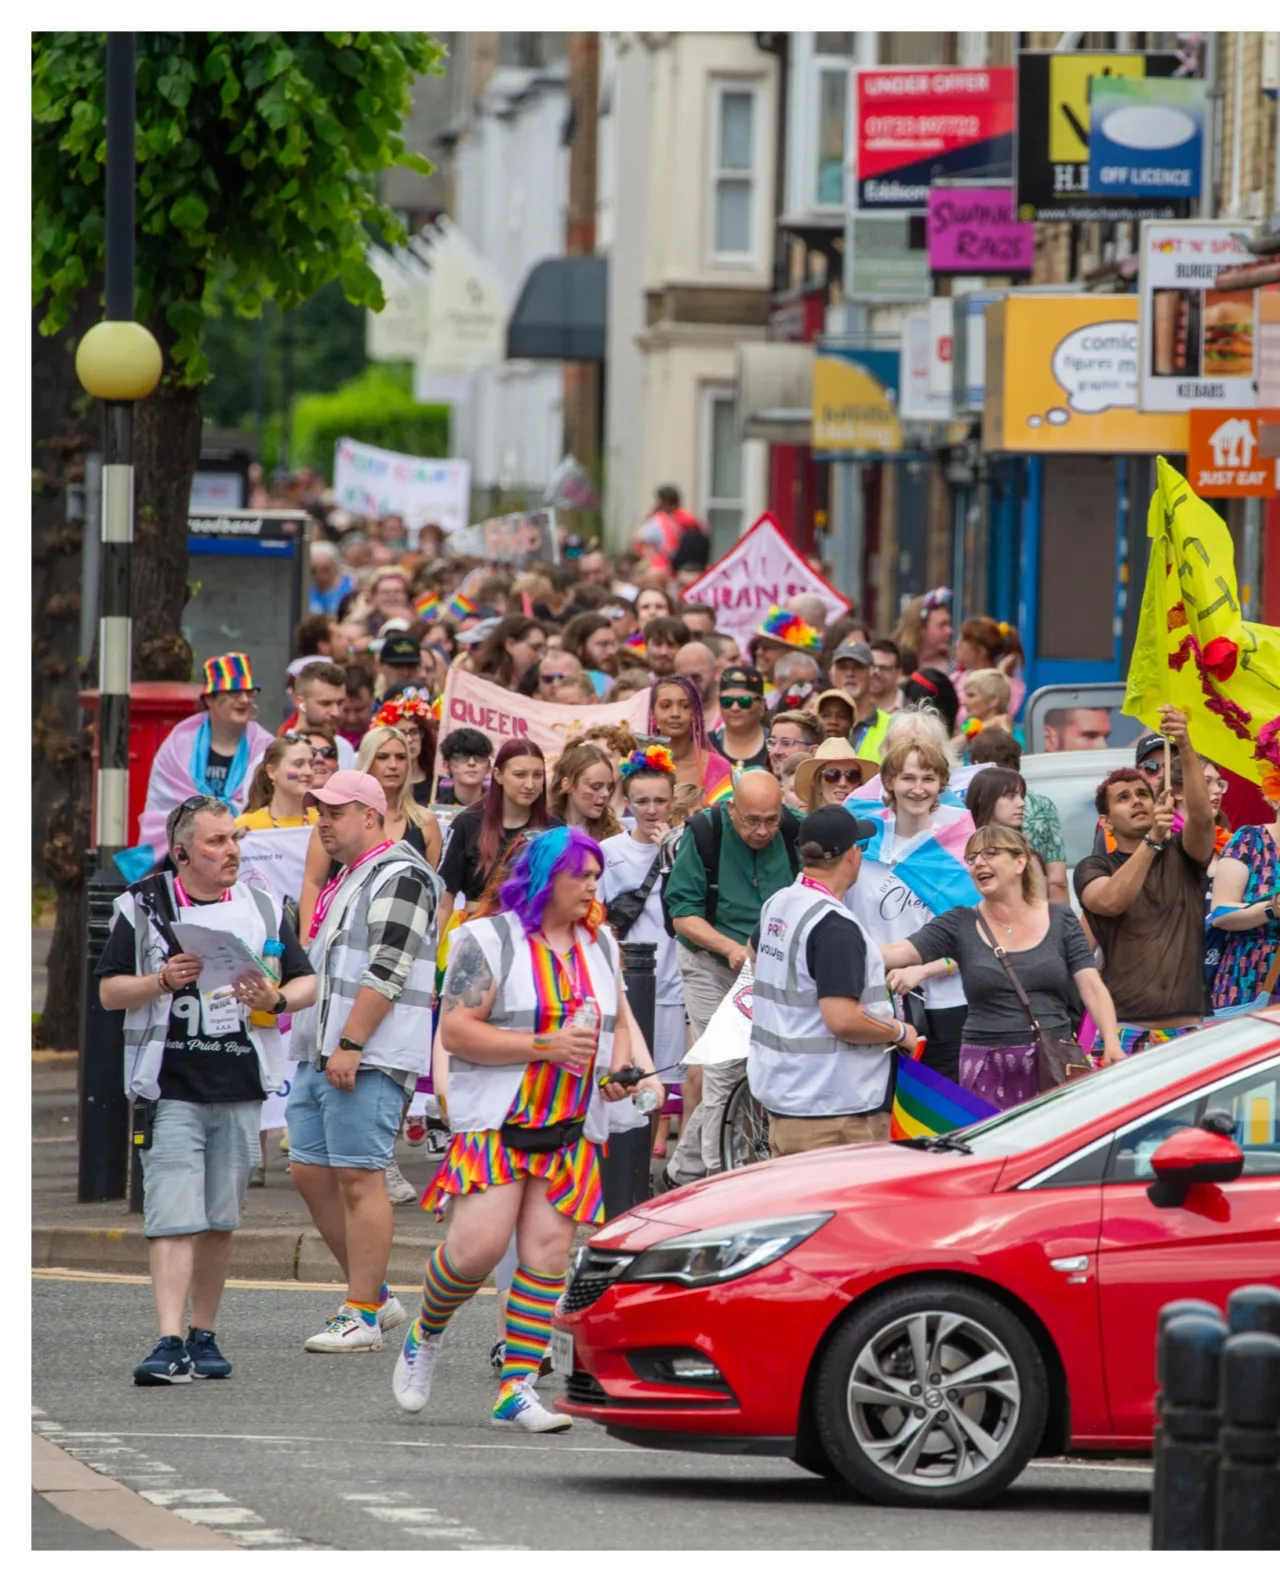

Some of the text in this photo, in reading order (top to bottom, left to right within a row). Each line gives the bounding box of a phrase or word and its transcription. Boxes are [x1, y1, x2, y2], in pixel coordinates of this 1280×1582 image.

[864, 73, 989, 95] UNDER OFFER
[1100, 166, 1193, 187] OFF LICENCE
[1177, 383, 1226, 399] KEBABS
[1198, 471, 1267, 487] JUST EAT
[450, 698, 529, 739] QUEER
[187, 1038, 222, 1052] Pride
